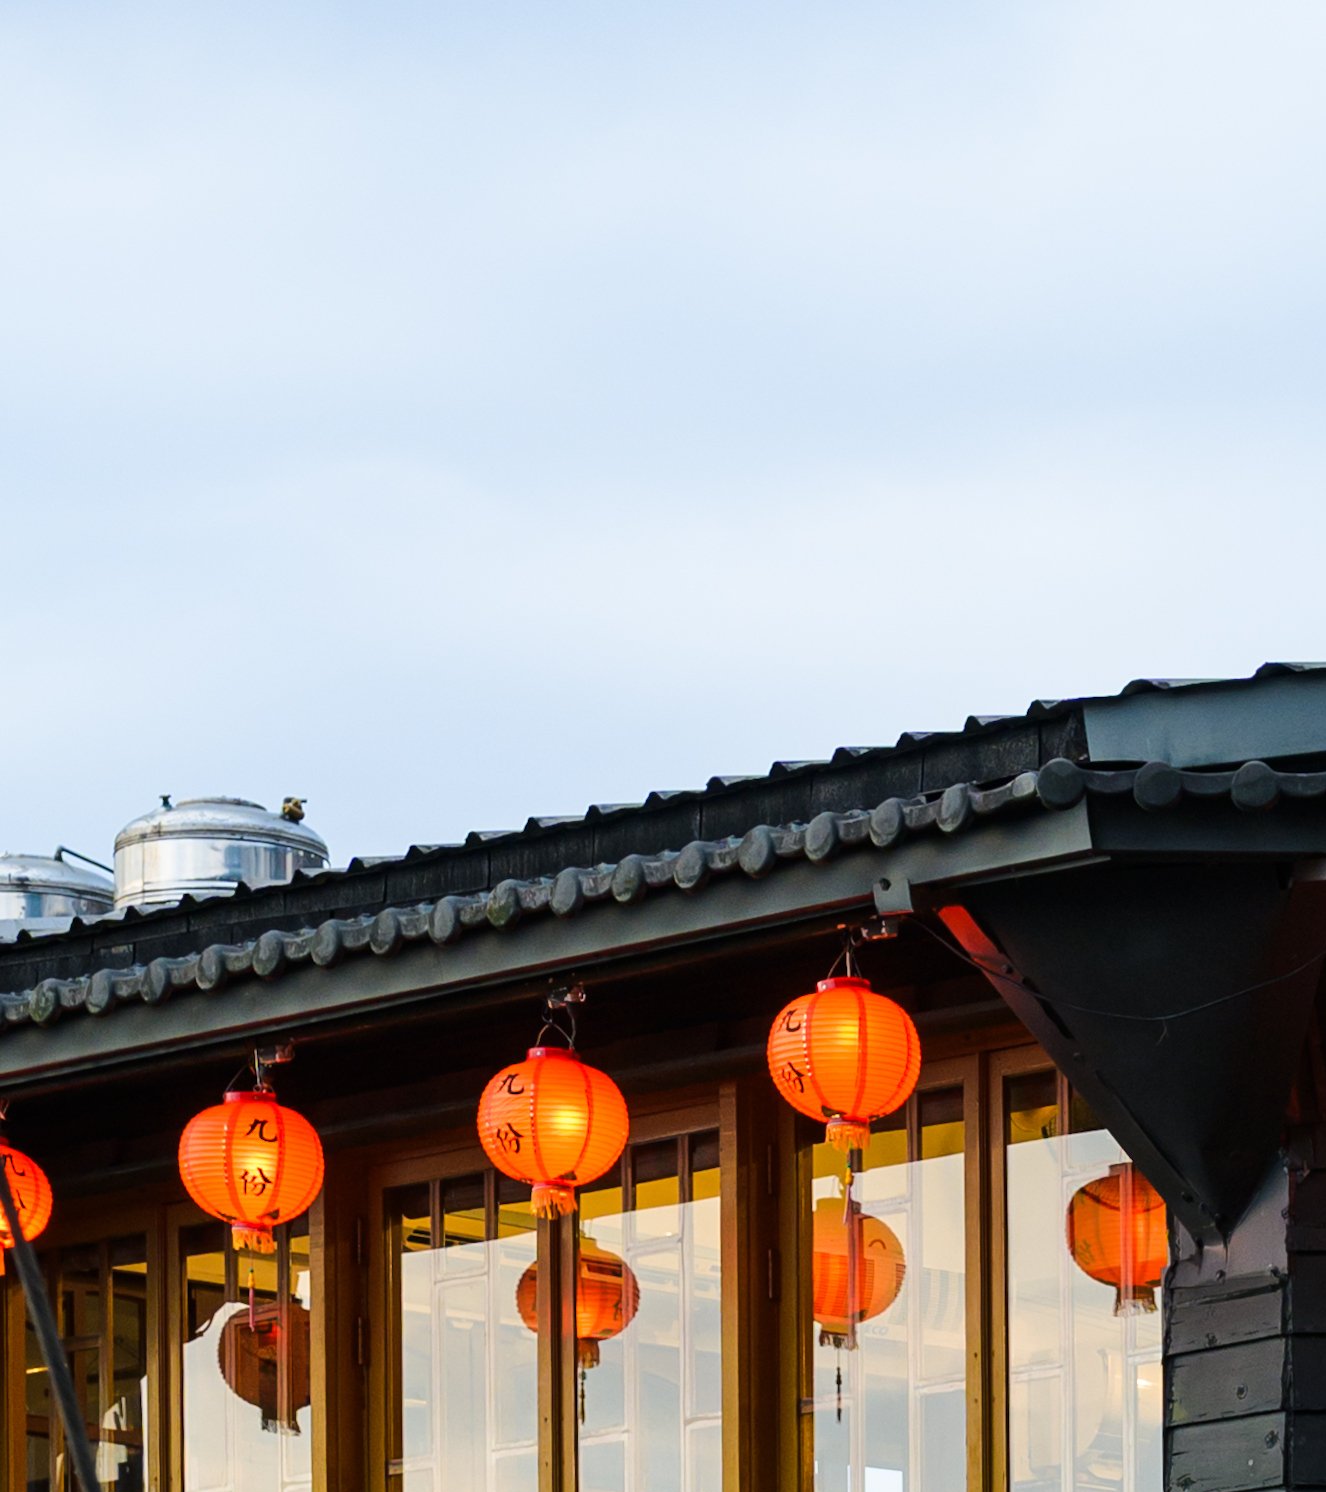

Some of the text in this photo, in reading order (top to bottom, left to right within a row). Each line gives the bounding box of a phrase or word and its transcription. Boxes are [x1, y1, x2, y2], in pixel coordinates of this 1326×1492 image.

[775, 1006, 805, 1095] 九份
[494, 1071, 527, 1155] 九份
[240, 1116, 279, 1197] 九份
